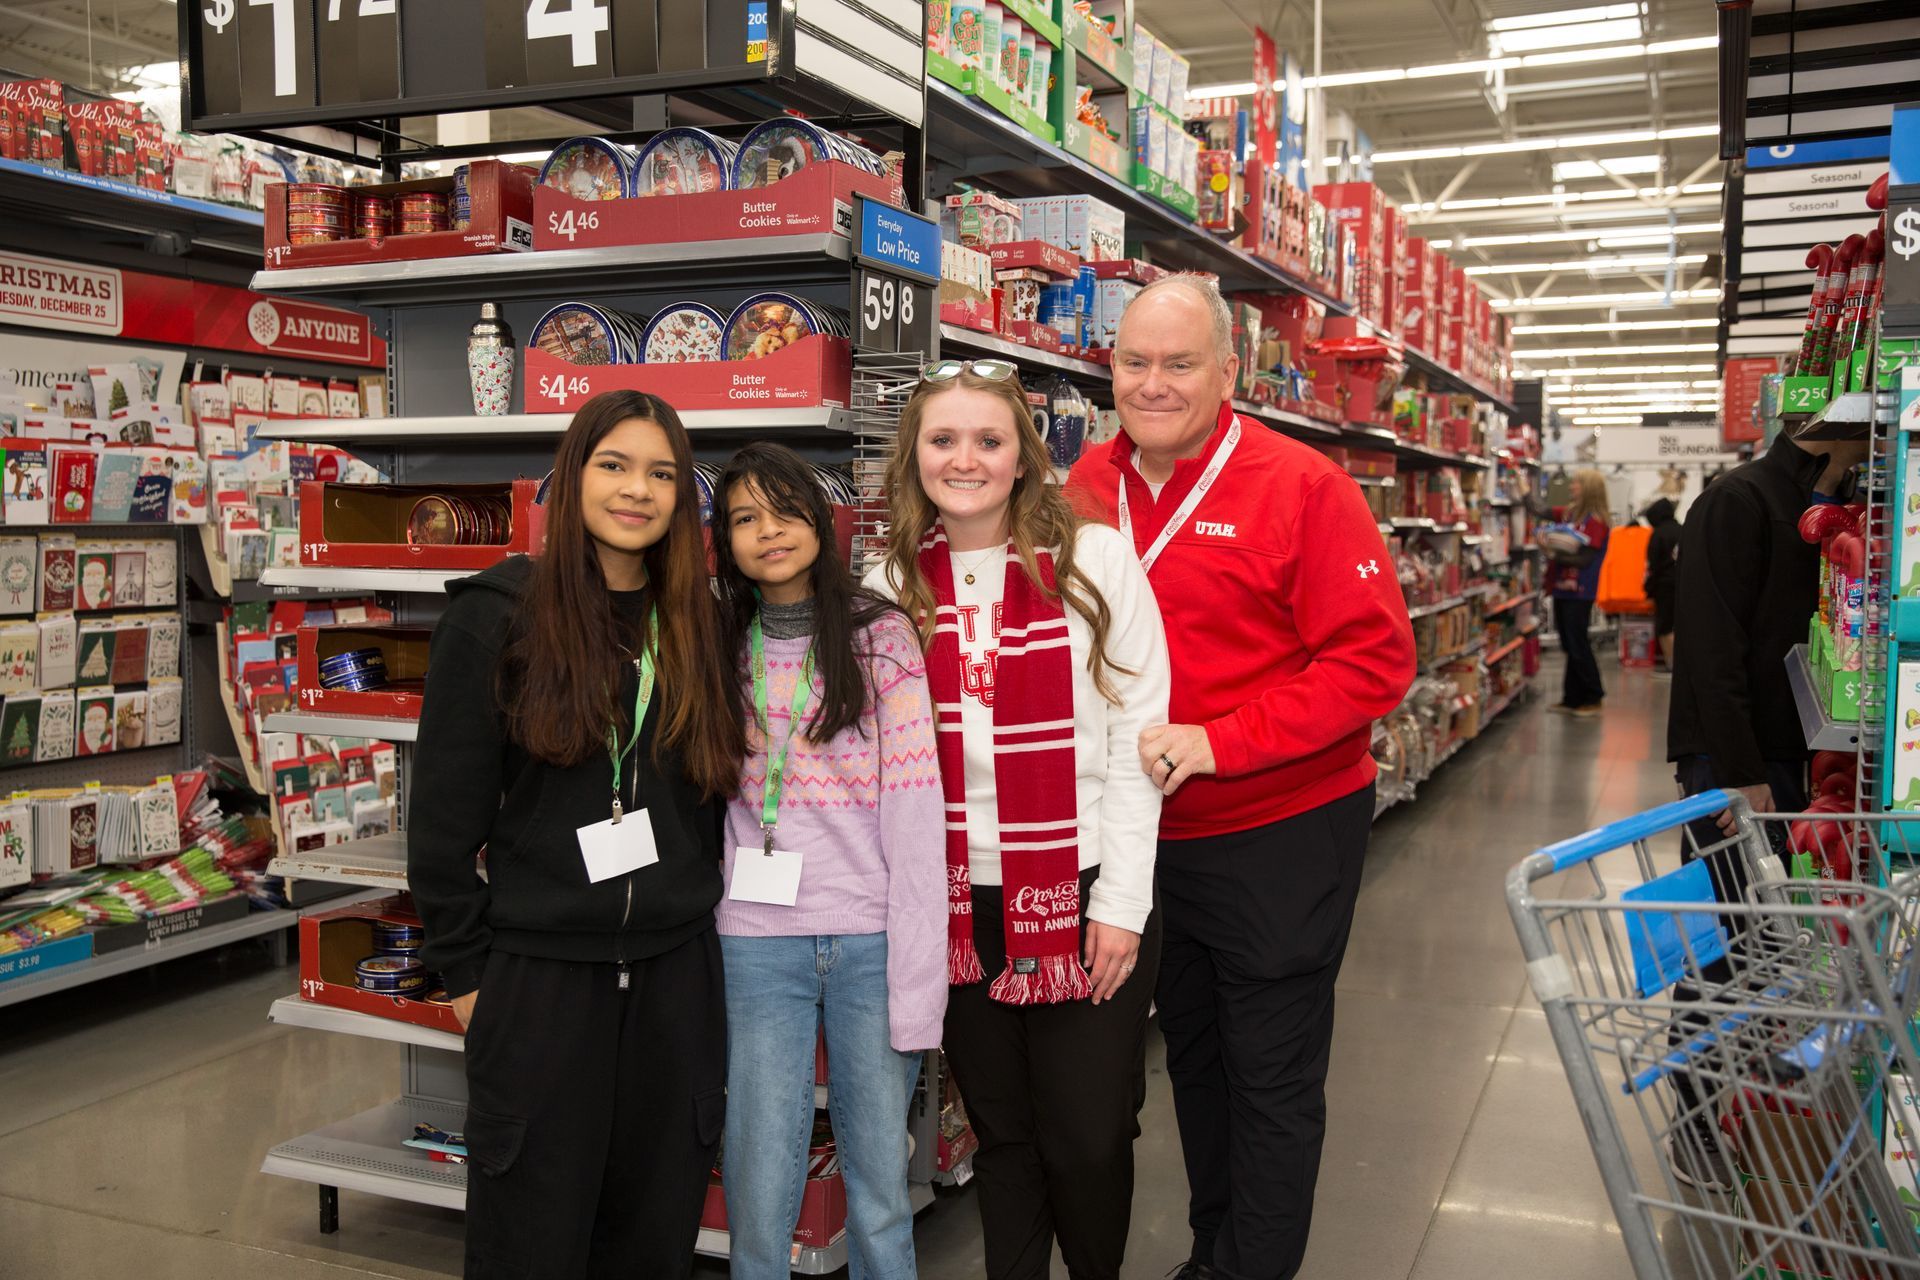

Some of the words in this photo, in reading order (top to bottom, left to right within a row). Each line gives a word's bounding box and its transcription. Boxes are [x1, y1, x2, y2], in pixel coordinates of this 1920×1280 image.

[27, 86, 62, 110] Spice
[69, 103, 98, 121] Old
[104, 106, 135, 128] Spice
[135, 129, 160, 151] Spice
[1811, 171, 1862, 184] Seasonal
[743, 202, 776, 213] Butter
[1788, 200, 1839, 212] Seasonal
[739, 215, 781, 228] Cookies
[786, 217, 811, 225] Walmart
[877, 215, 904, 237] Everyday
[482, 234, 496, 242] Style
[877, 233, 896, 256] Low
[897, 238, 920, 265] Price
[41, 297, 91, 317] DECEMBER
[95, 305, 106, 318] 25
[284, 316, 360, 345] ANYONE
[733, 374, 766, 385] Butter
[729, 387, 770, 399] Cookies
[1195, 521, 1234, 537] UTAH
[1012, 921, 1039, 934] 10TH
